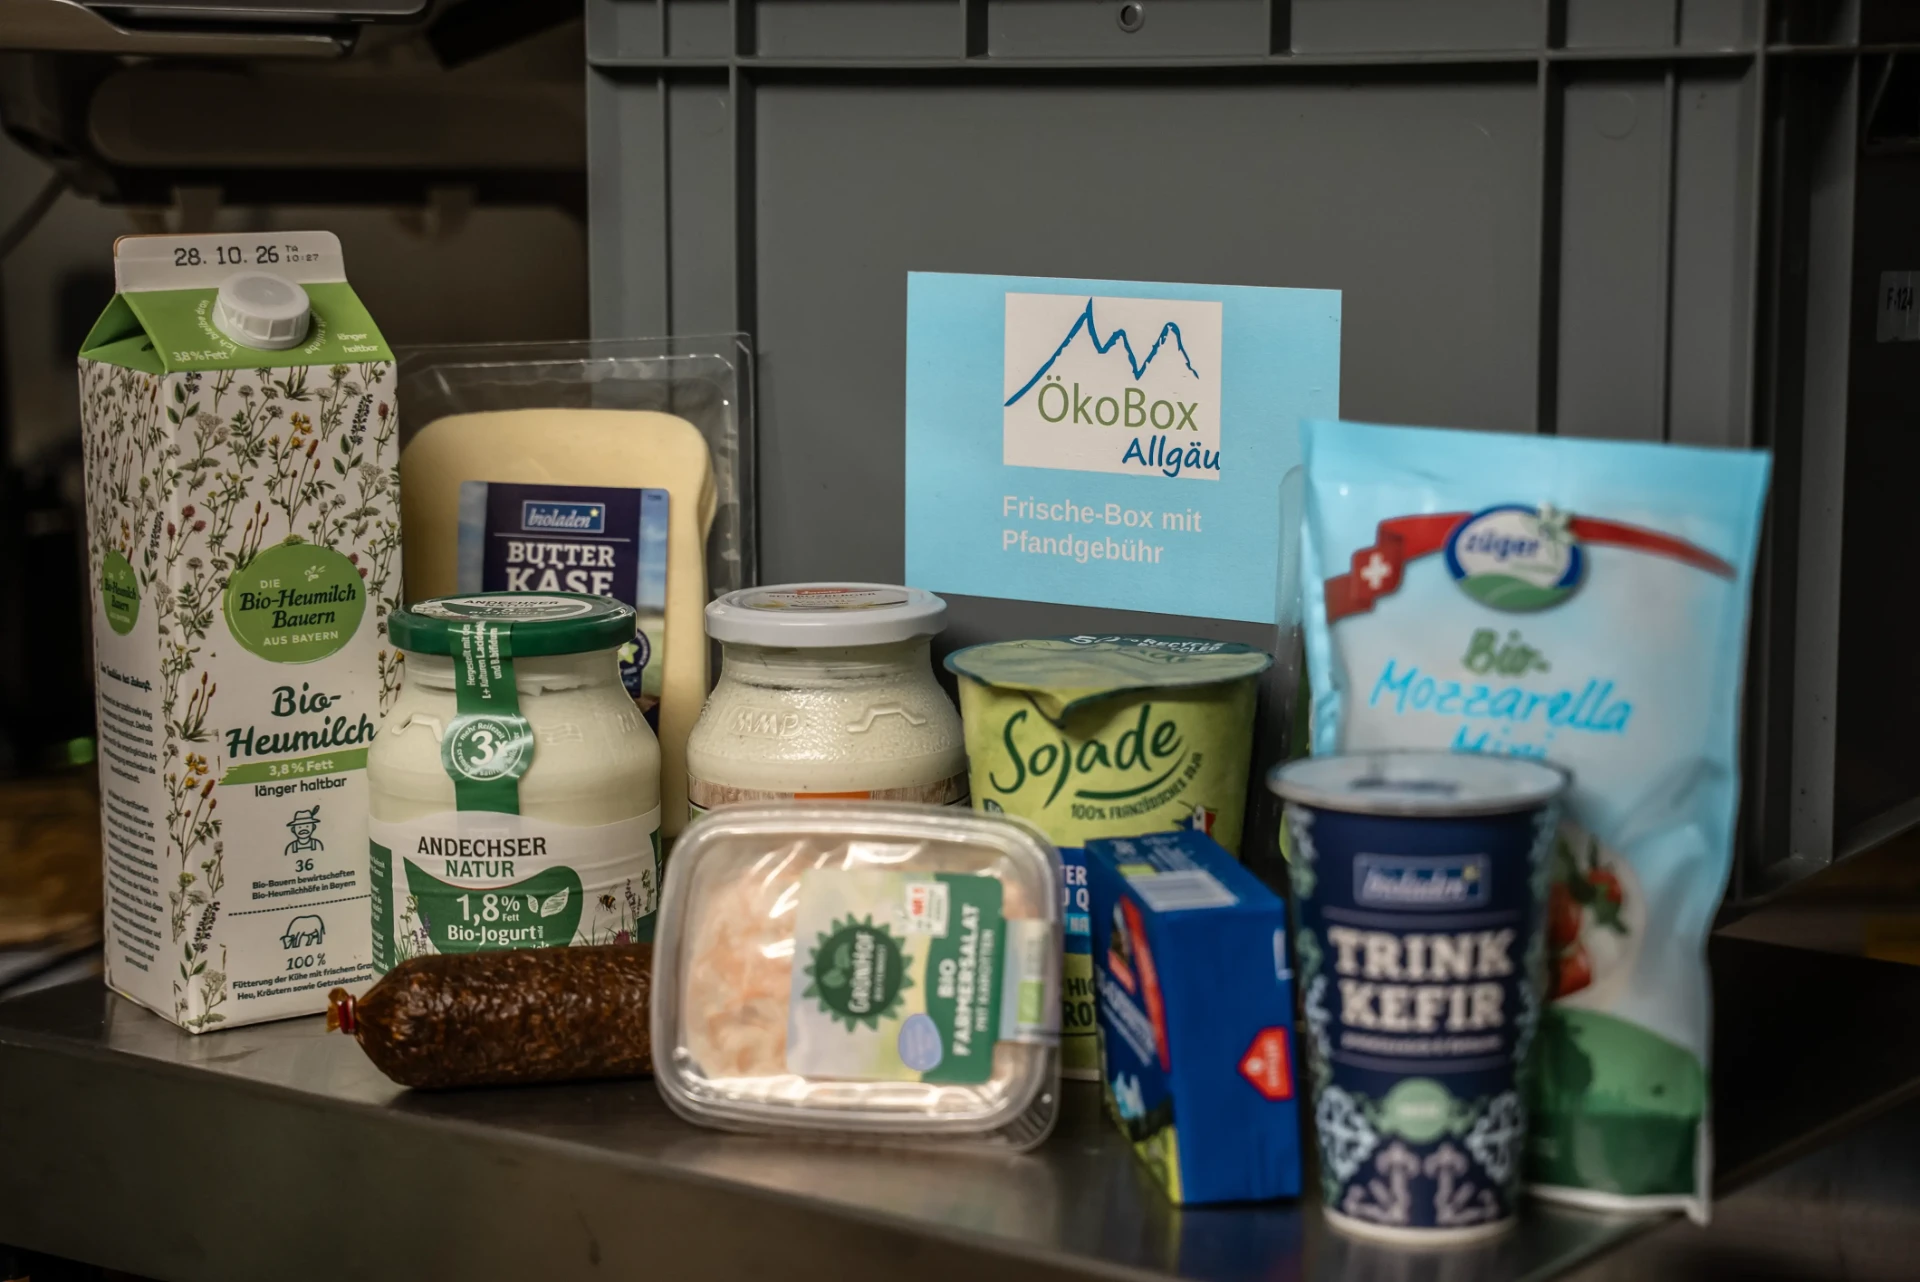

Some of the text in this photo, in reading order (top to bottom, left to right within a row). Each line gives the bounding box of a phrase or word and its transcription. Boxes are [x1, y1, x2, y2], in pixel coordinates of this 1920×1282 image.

[174, 245, 279, 266] 28. 10. 26
[286, 253, 319, 263] 10:27
[1037, 375, 1199, 431] ÖkoBox
[1121, 435, 1220, 478] Allgäu
[527, 507, 591, 529] bioladen
[1002, 495, 1203, 532] Frische-Box mit
[506, 541, 616, 567] BUTTER
[1002, 530, 1164, 565] Pfandgebühr
[260, 579, 281, 589] DIE
[505, 561, 614, 599] KÄSE
[239, 583, 357, 612] Bio-Heumilch
[271, 610, 336, 629] Bauern
[263, 630, 339, 647] AUS BAYERN
[491, 664, 502, 679] und
[271, 682, 341, 717] Bio-
[1369, 659, 1634, 736] Mozzarella
[225, 713, 378, 758] Heumilch
[460, 722, 506, 741] mehr Reifezeit
[306, 759, 334, 772] Fett
[989, 703, 1184, 809] Sojade
[255, 783, 298, 798] länger
[300, 776, 347, 792] haltbar
[1071, 803, 1106, 820] 100%
[417, 836, 547, 858] ANDECHSER
[294, 858, 314, 872] 36
[445, 860, 515, 878] NATUR
[252, 870, 355, 889] Bio-Bauern bewirtschaften
[321, 883, 329, 891] in
[456, 893, 521, 926] 1,8 %
[502, 912, 520, 922] Fett
[447, 924, 537, 946] Bio-Jogurt
[285, 952, 326, 971] 100 %
[1327, 924, 1518, 982] TRINK
[232, 978, 273, 989] Fütterung
[288, 973, 308, 981] Kühe
[309, 969, 322, 979] mit
[937, 958, 956, 999] BIO
[952, 902, 980, 1056] FARMERSALAT
[237, 992, 256, 1000] Heu,
[256, 986, 292, 998] Kräutern
[293, 982, 316, 992] sowie
[1337, 980, 1507, 1034] KEFIR
